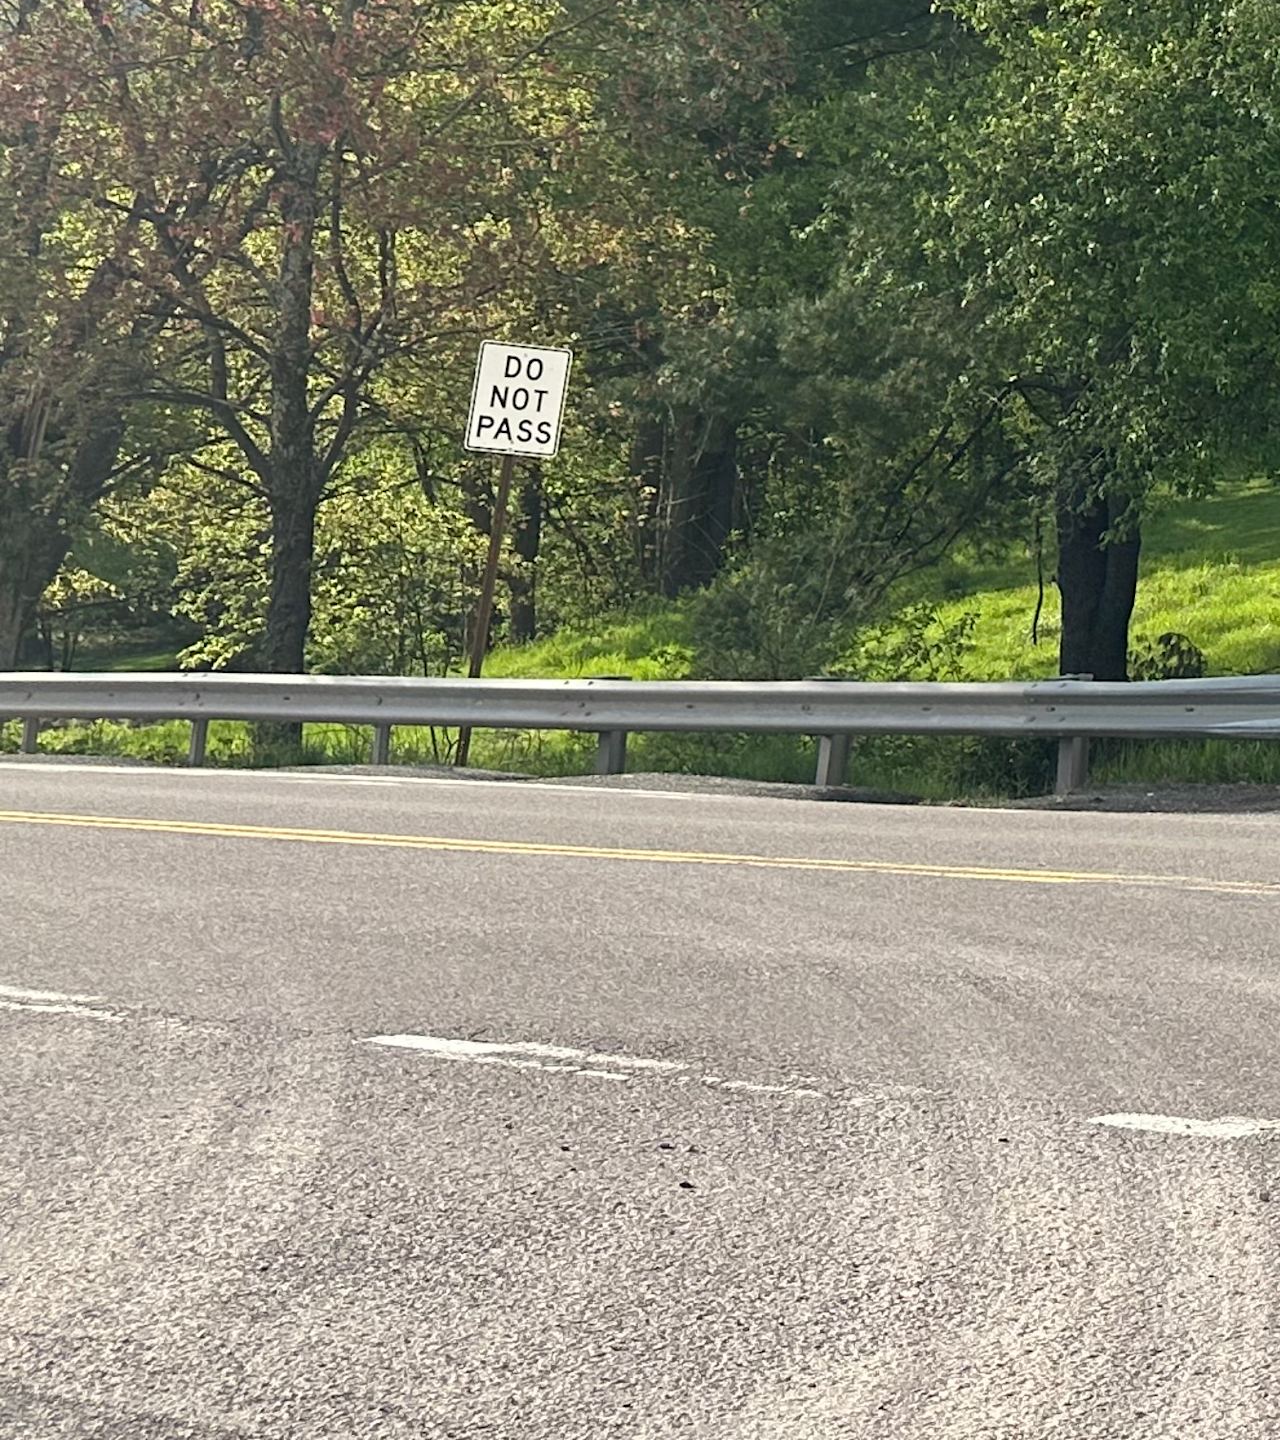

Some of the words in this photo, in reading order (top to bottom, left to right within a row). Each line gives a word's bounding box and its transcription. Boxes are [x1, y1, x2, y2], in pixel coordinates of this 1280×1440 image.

[504, 355, 543, 380] DO
[490, 385, 548, 412] NOT
[476, 415, 552, 444] PASS
